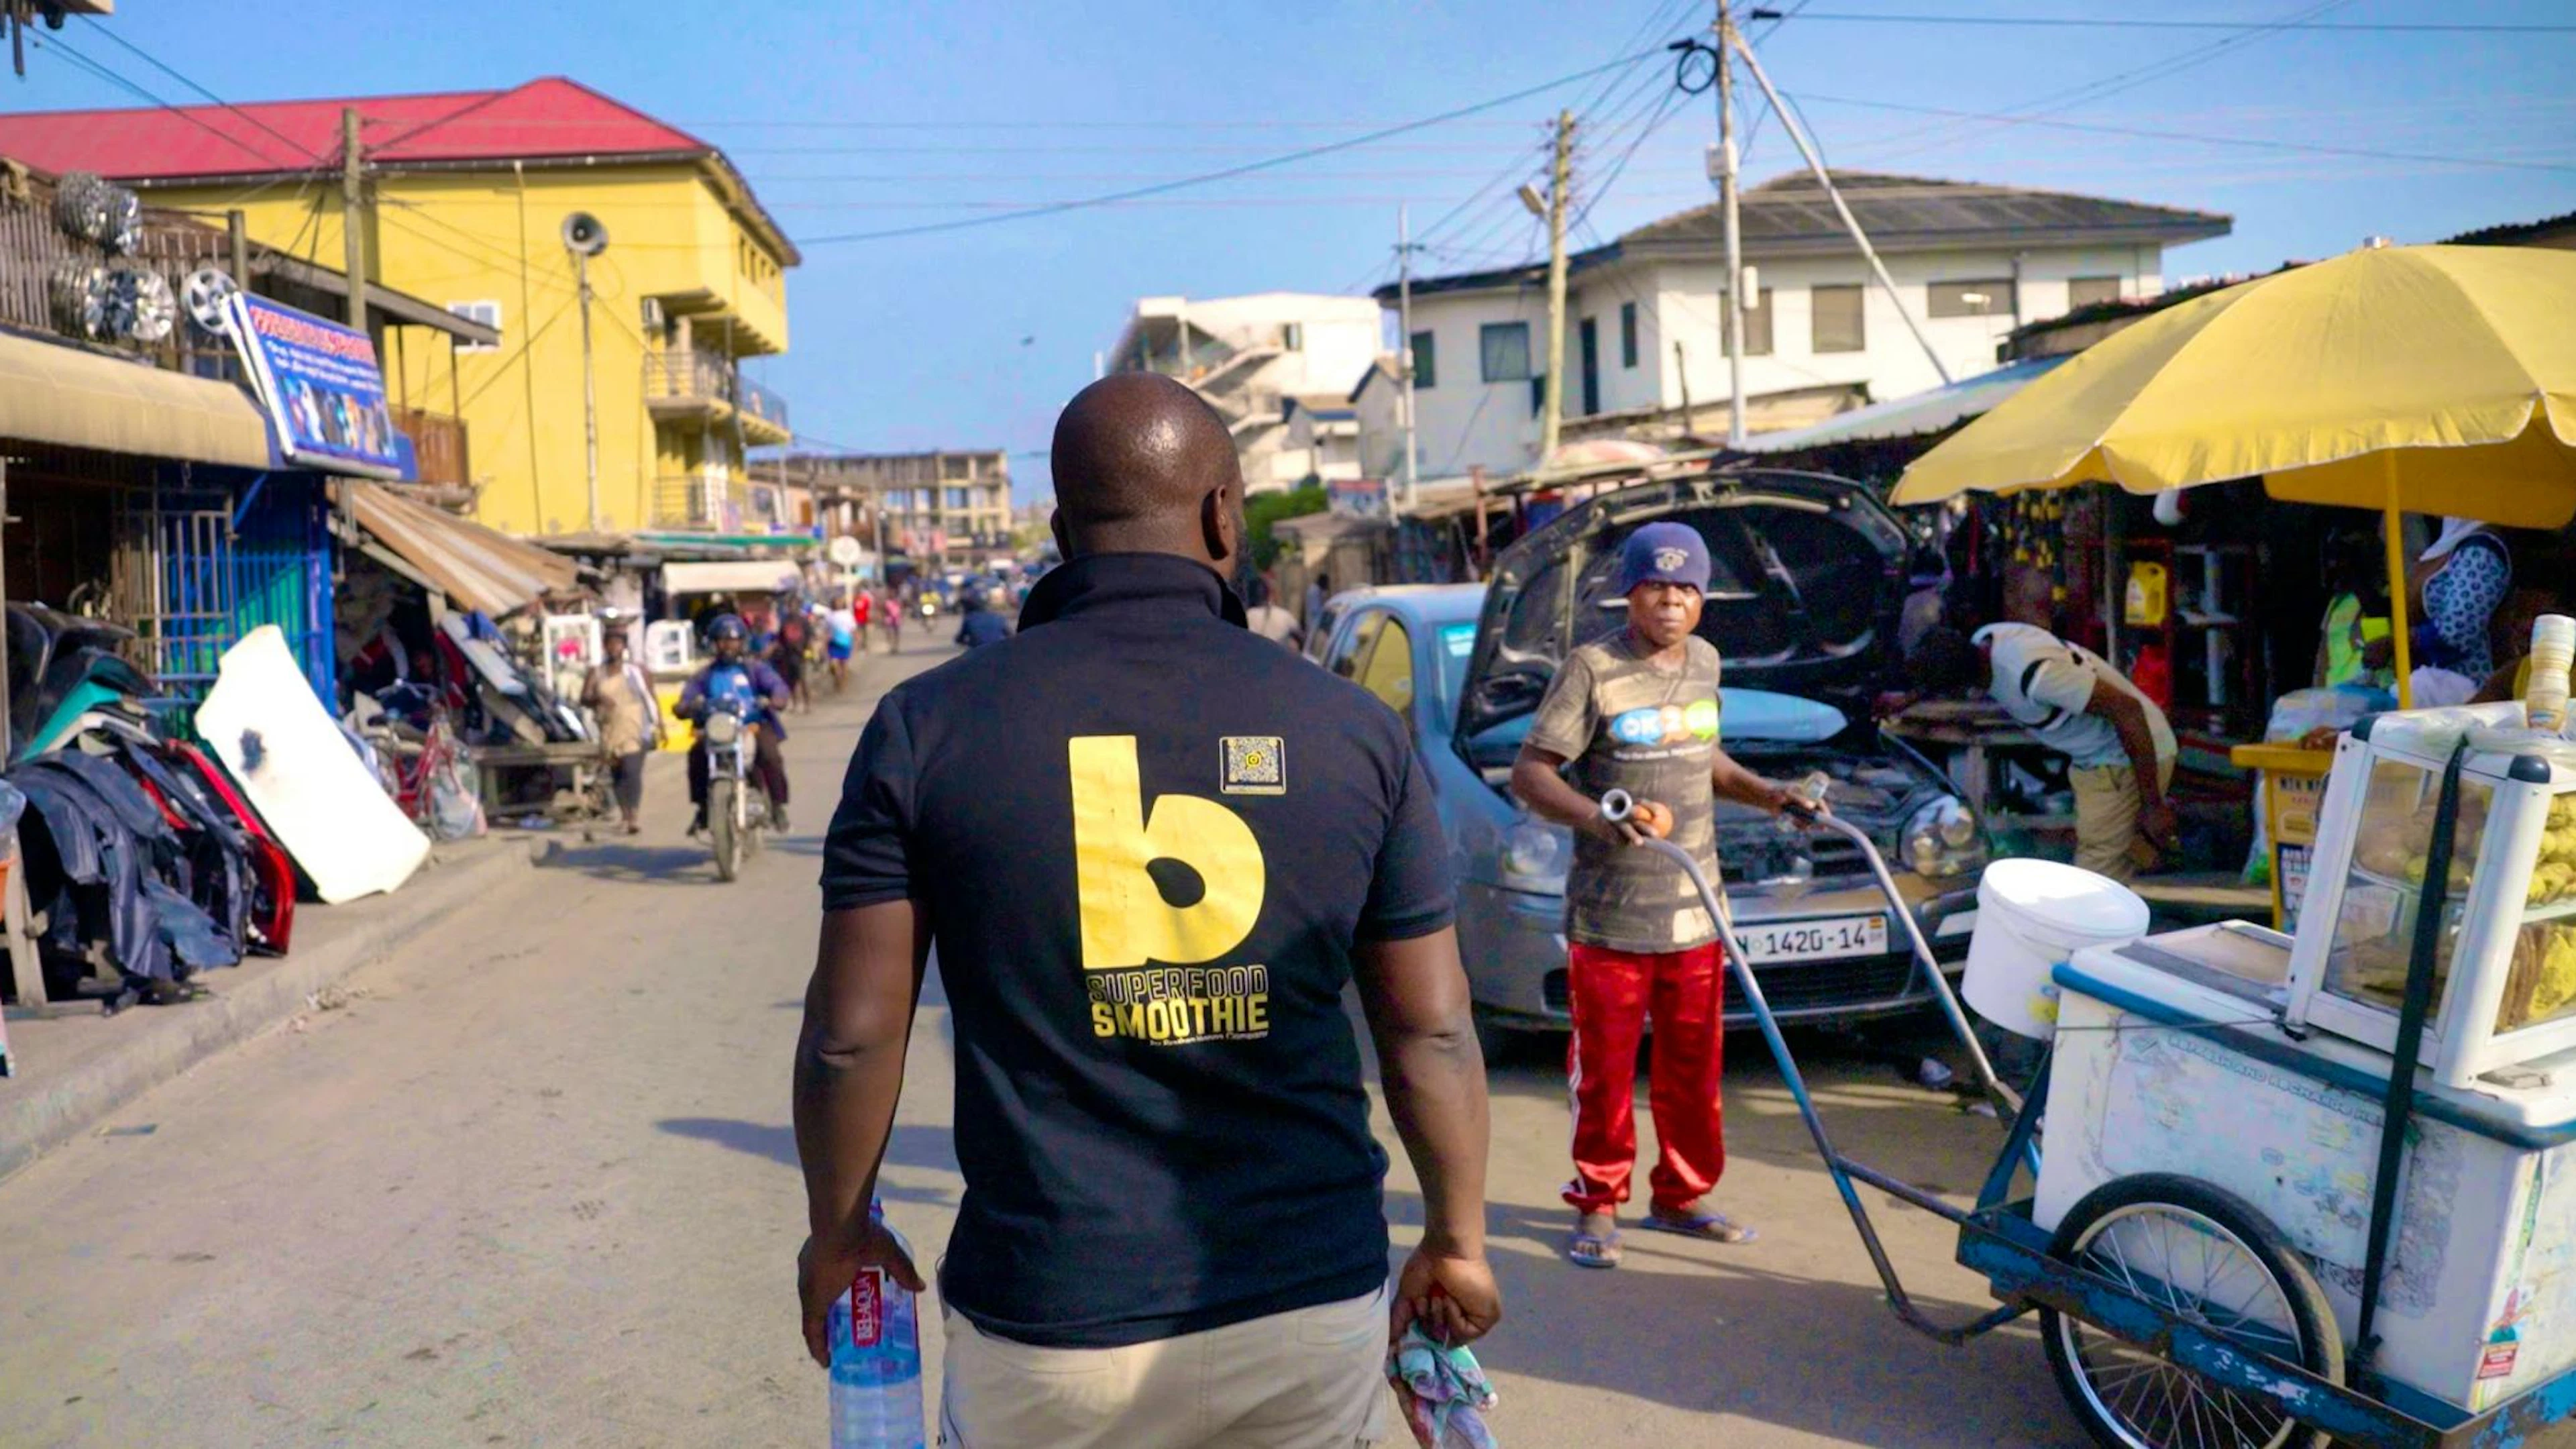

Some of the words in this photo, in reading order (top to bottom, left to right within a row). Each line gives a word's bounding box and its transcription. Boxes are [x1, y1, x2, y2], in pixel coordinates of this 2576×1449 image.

[1068, 735, 1266, 969] b
[1765, 922, 1866, 955] 1420-14
[1085, 964, 1269, 1006] SUPERFOOD
[1091, 993, 1269, 1040] SMOOTHIE
